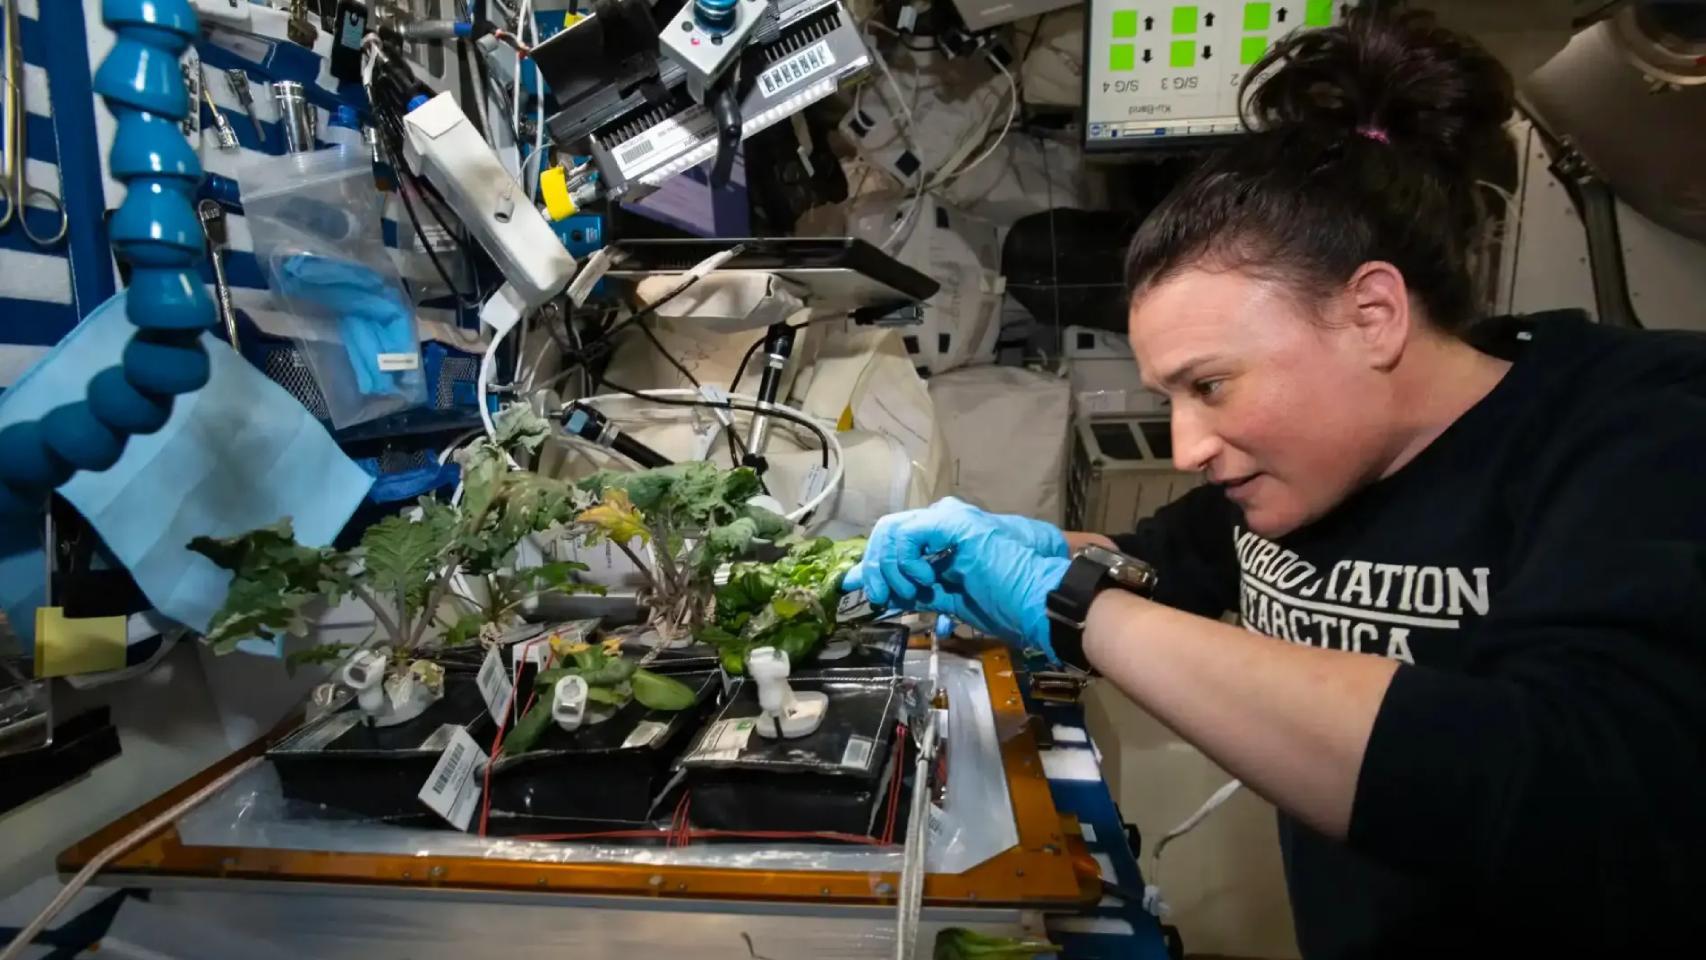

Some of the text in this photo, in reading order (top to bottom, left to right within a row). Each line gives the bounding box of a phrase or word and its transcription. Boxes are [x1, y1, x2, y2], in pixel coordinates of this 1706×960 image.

[1160, 76, 1198, 90] S/G 3
[1230, 73, 1239, 86] 2
[1102, 80, 1139, 93] S/G 4
[1128, 104, 1171, 114] Ku-Band
[1241, 583, 1416, 665] TARCTICA
